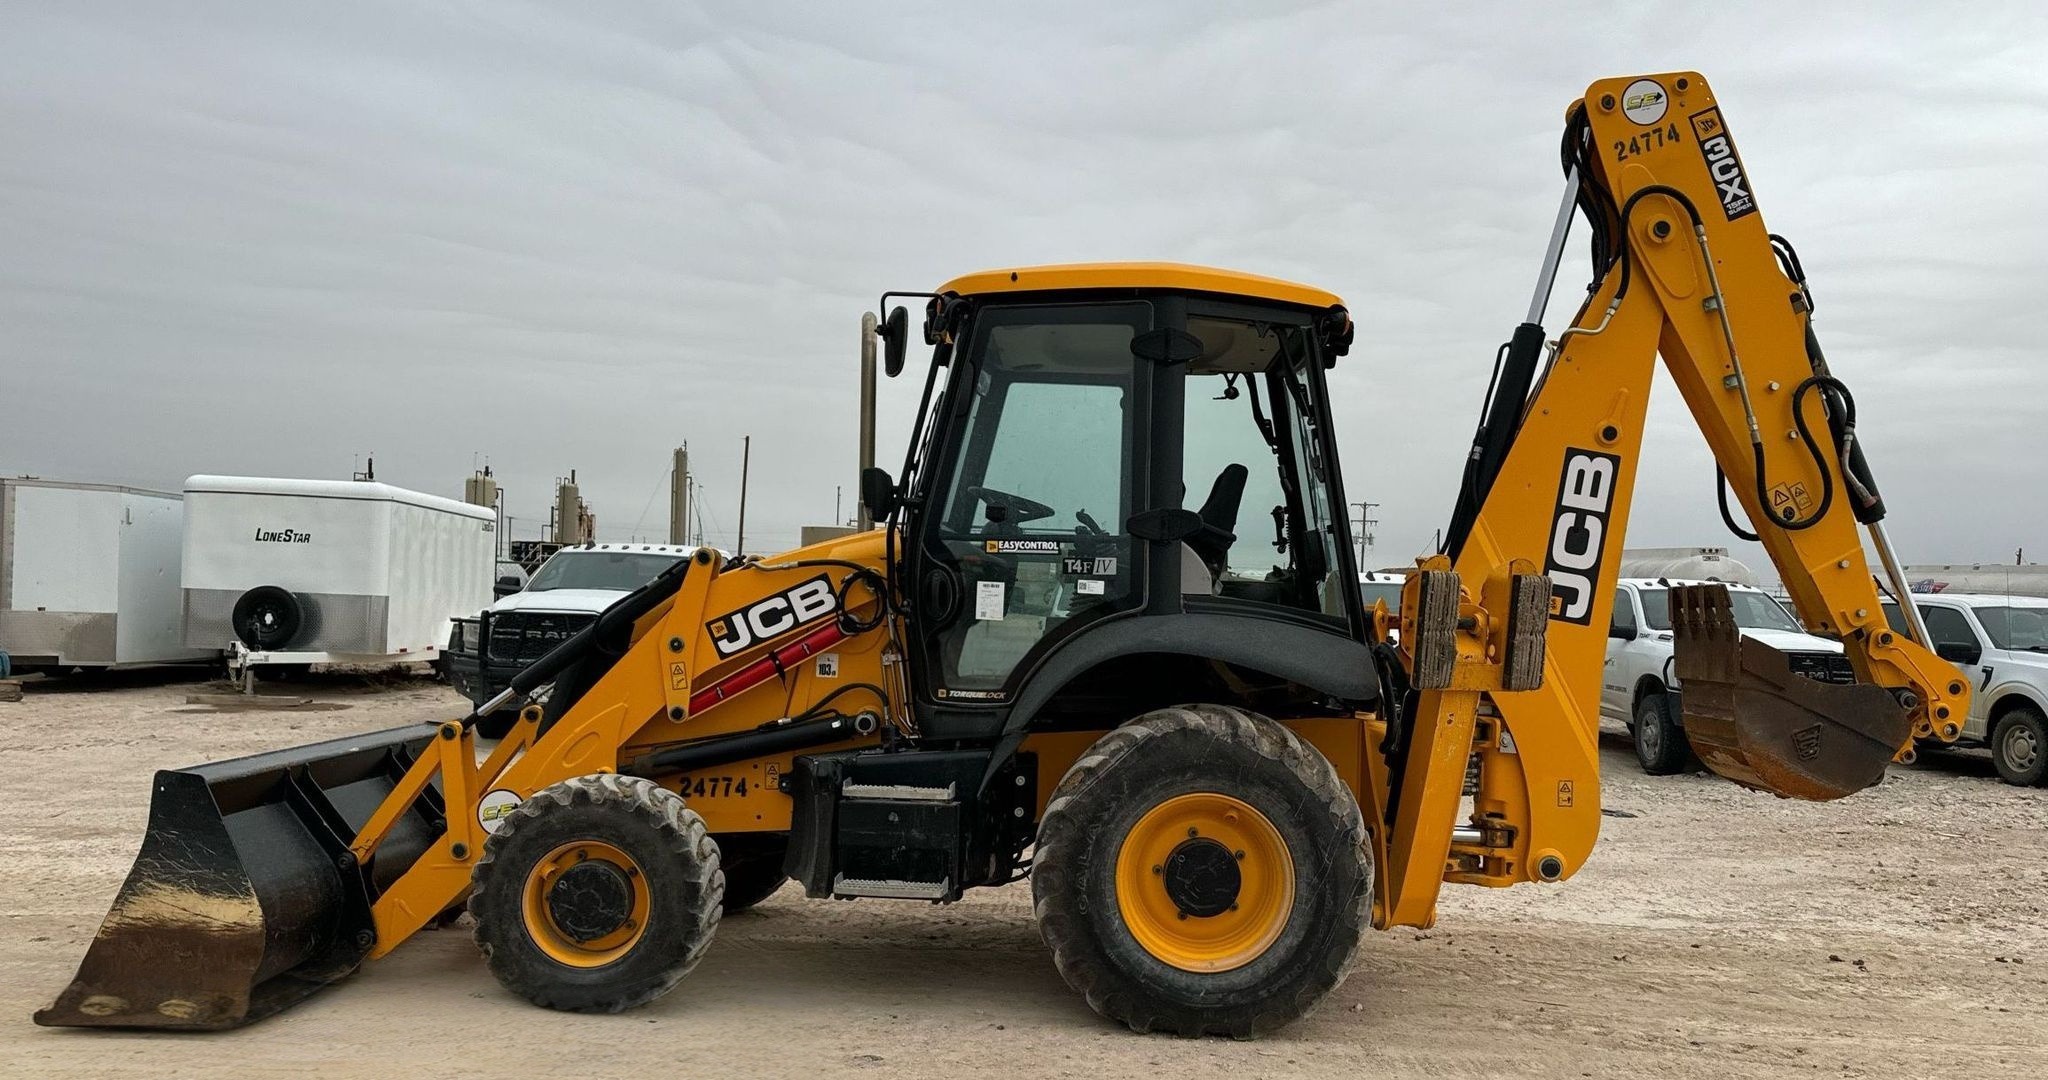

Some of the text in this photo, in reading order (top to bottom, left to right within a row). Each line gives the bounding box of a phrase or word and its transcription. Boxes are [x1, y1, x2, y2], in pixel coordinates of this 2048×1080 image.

[1614, 123, 1680, 162] 24774
[1704, 136, 1749, 205] 3CX
[998, 541, 1059, 552] EASYCONTROL
[1549, 455, 1614, 619] JCB
[717, 579, 836, 654] JCB
[949, 690, 1006, 699] TORQUELOCK
[679, 776, 748, 798] 24774
